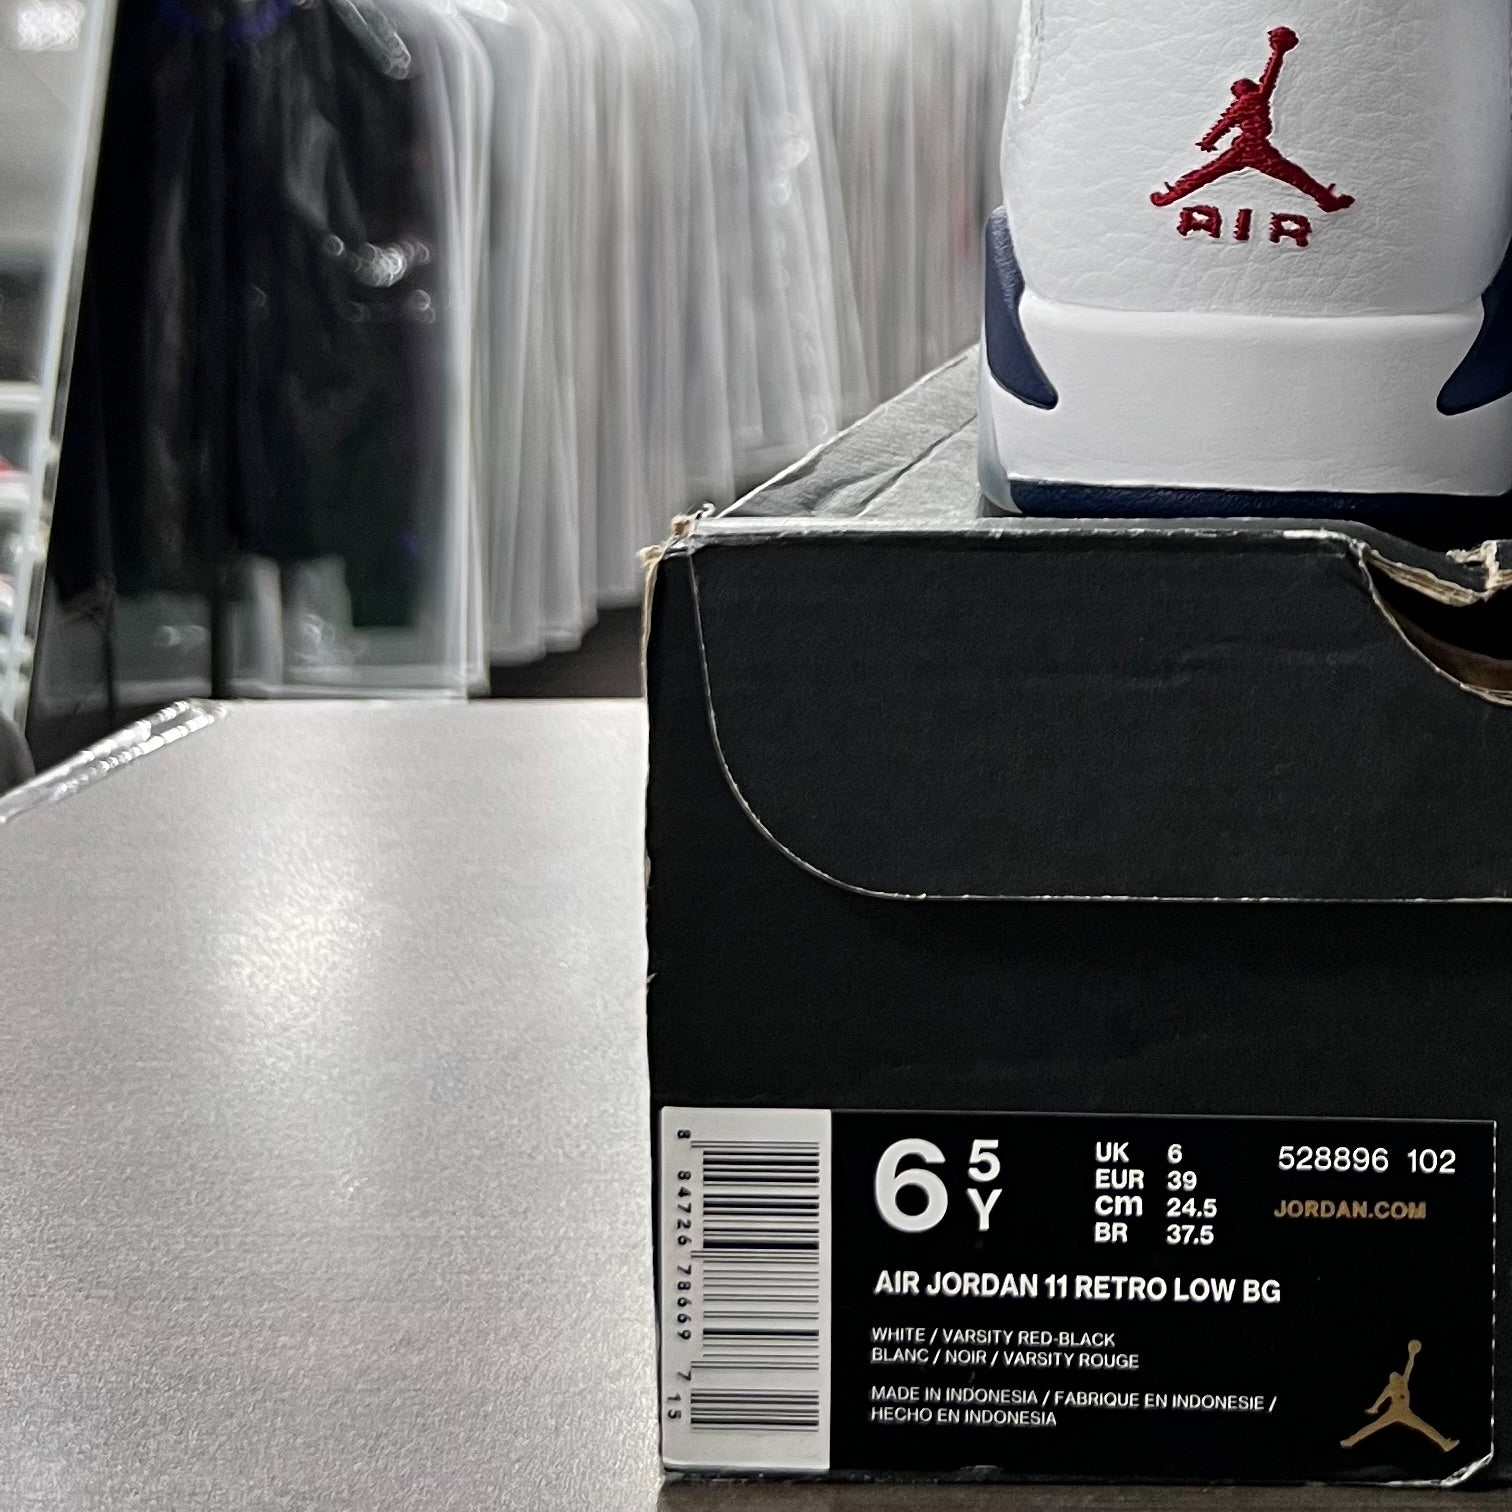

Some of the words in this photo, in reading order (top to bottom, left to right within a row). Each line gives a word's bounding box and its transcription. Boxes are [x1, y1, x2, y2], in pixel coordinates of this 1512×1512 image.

[1176, 204, 1313, 248] AIR
[677, 1130, 693, 1141] 8
[969, 1139, 1002, 1183] 5
[1096, 1142, 1131, 1164] UK
[1168, 1144, 1184, 1165] 6
[1279, 1146, 1390, 1174] 528896
[1408, 1149, 1457, 1175] 102
[875, 1139, 950, 1234] 6
[1096, 1169, 1146, 1191] EUR
[1168, 1171, 1199, 1193] 39
[677, 1171, 694, 1247] 84726
[967, 1188, 1004, 1233] Y
[1095, 1195, 1144, 1218] cm
[1167, 1198, 1219, 1219] 24.5
[1274, 1200, 1428, 1220] JORDAN.COM
[1095, 1222, 1129, 1244] BR
[1167, 1224, 1216, 1247] 37.5
[875, 1270, 921, 1296] AIR
[927, 1272, 1039, 1299] JORDAN
[1045, 1274, 1069, 1300] 11
[1076, 1275, 1169, 1302] RETRO
[1174, 1278, 1237, 1304] LOW
[1243, 1279, 1282, 1305] BG
[677, 1265, 693, 1342] 78669
[873, 1327, 927, 1344] WHITE
[930, 1328, 940, 1346] /
[943, 1329, 1015, 1346] VARSITY
[1018, 1331, 1117, 1348] RED-BLACK
[872, 1348, 930, 1364] BLANC
[933, 1349, 943, 1367] /
[946, 1350, 988, 1365] NOIR
[991, 1351, 1000, 1368] /
[1004, 1351, 1076, 1368] VARSITY
[1079, 1353, 1141, 1370] ROUGE
[678, 1371, 693, 1383] 7
[872, 1386, 921, 1402] MADE
[925, 1388, 943, 1402] IN
[946, 1388, 1039, 1405] INDONESIA
[1042, 1390, 1052, 1408] /
[1055, 1391, 1141, 1409] FABRIQUE
[1145, 1394, 1169, 1410] EN
[1173, 1394, 1266, 1412] INDONESIE
[1269, 1397, 1278, 1414] /
[872, 1407, 934, 1423] HECHO
[938, 1408, 961, 1425] EN
[965, 1410, 1058, 1427] INDONESIA
